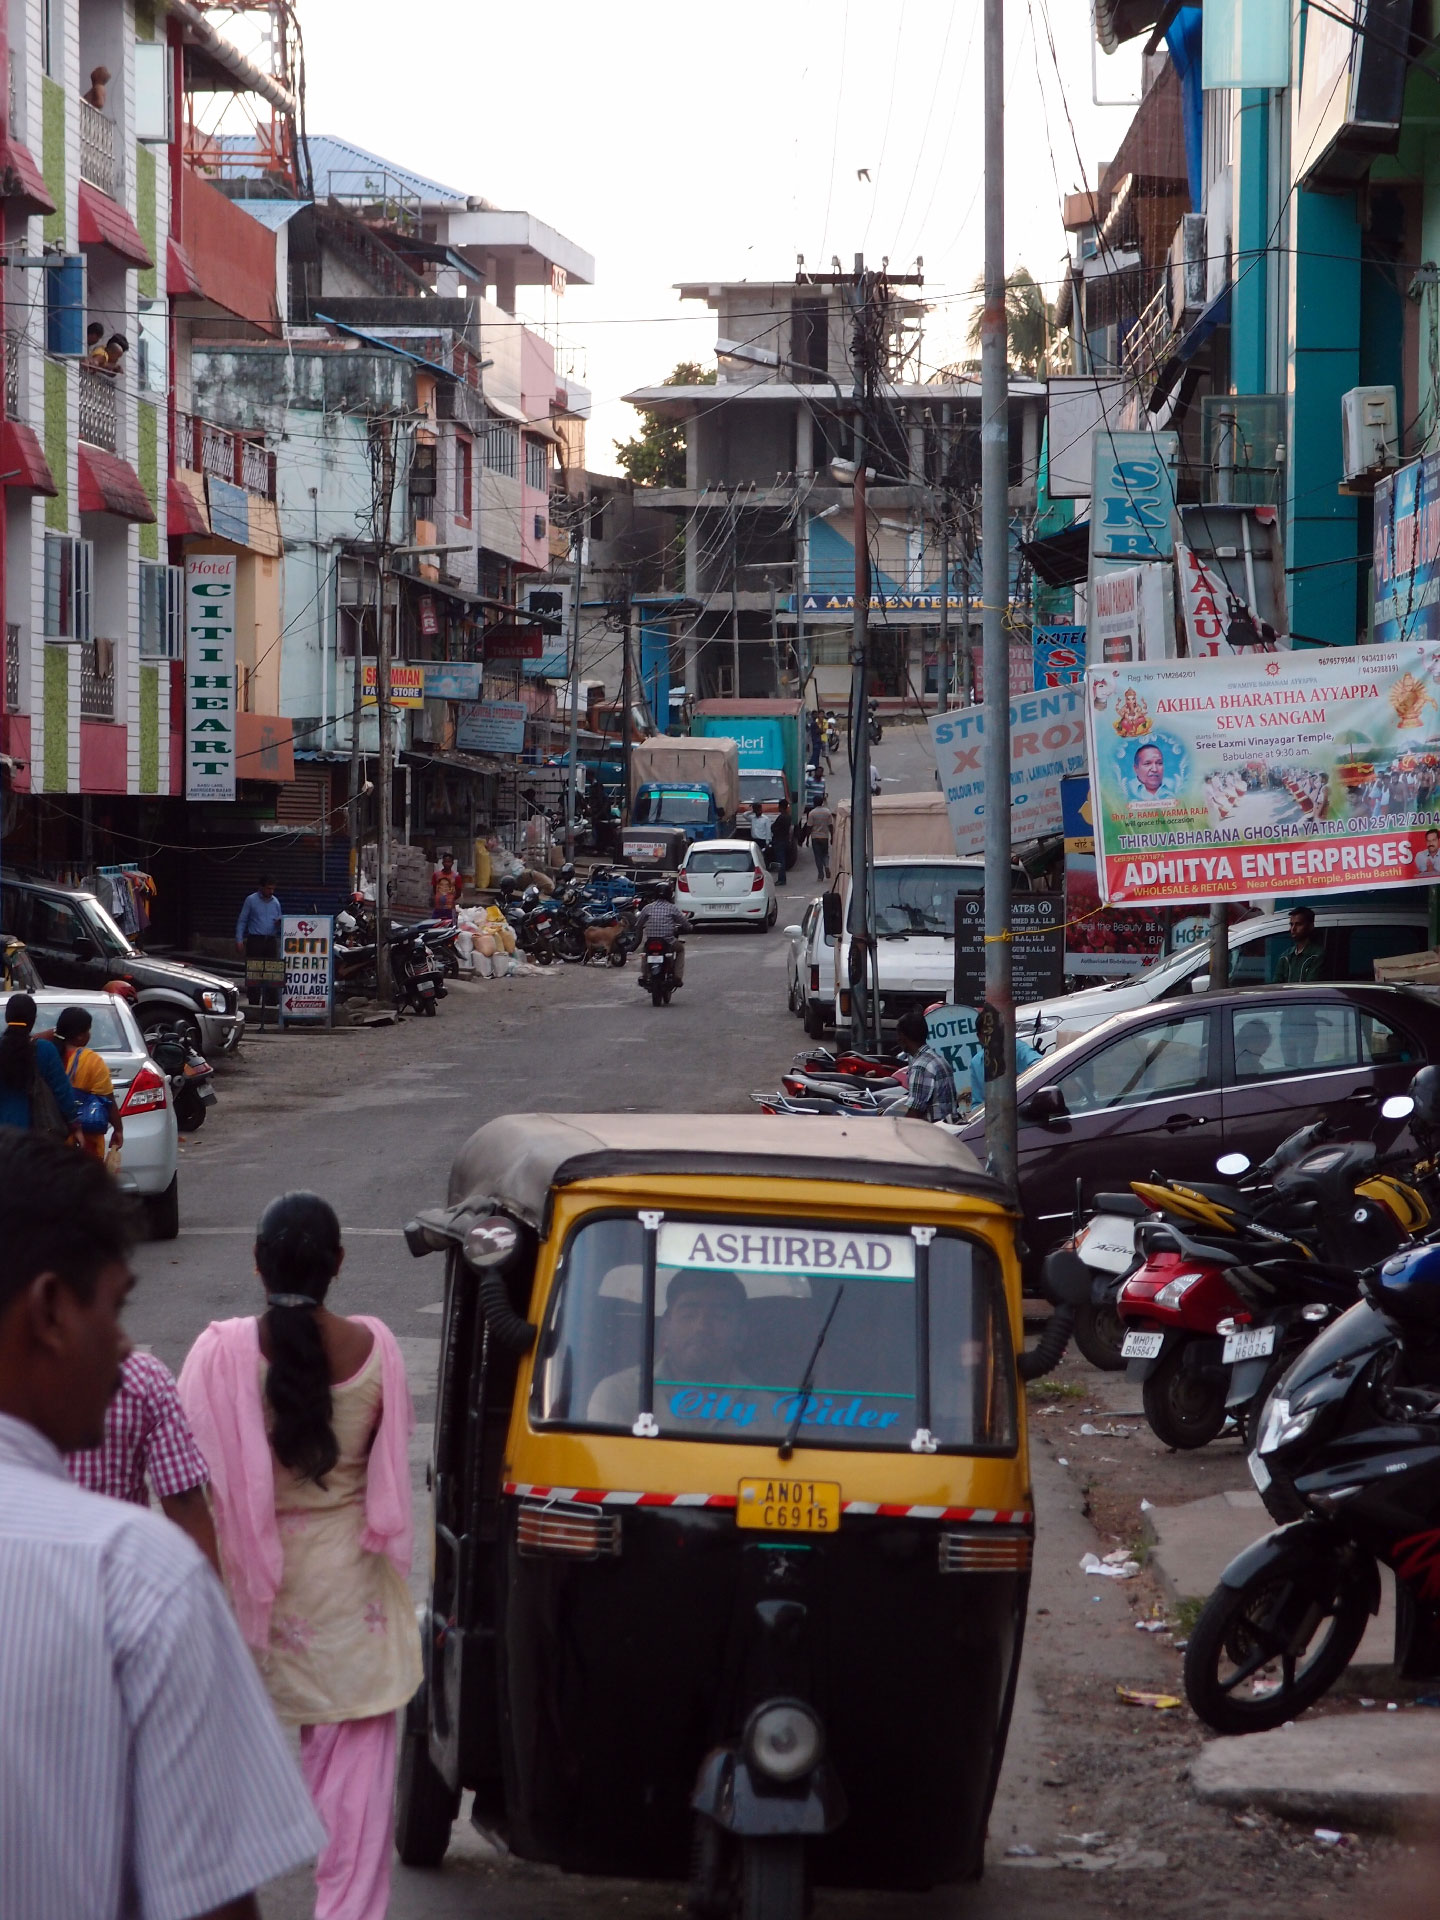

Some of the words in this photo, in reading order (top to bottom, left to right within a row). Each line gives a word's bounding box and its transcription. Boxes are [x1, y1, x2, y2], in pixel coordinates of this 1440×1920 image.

[187, 560, 235, 575] Hotel
[190, 583, 232, 662] CITI
[492, 646, 533, 655] TRAVELS
[390, 669, 420, 685] MMAN
[393, 687, 419, 697] STORE
[1156, 696, 1216, 713] AKHILA
[1219, 688, 1307, 709] BHARATHA
[1310, 684, 1379, 703] AYYAPPA
[189, 675, 233, 775] HEART
[936, 691, 1079, 744] STENT
[1217, 714, 1255, 730] SEVA
[1259, 708, 1326, 728] SANGAM
[1196, 740, 1217, 750] Sree
[1218, 738, 1246, 749] Laxmi
[1248, 734, 1296, 747] Vinayagar
[1297, 732, 1335, 744] Temple,
[1222, 751, 1264, 762] Babulane
[1265, 750, 1274, 759] at
[1275, 748, 1294, 757] 9:30
[1137, 811, 1159, 820] RAMA
[1161, 809, 1188, 818] VARMA
[1190, 807, 1209, 816] RAJA
[1118, 828, 1240, 850] THIRUVABHARANA
[1244, 823, 1299, 841] GHOSHA
[1302, 818, 1345, 836] YATRA
[1348, 816, 1367, 832] ON
[1371, 810, 1440, 829] 25/12/2014
[1136, 820, 1155, 828] grace
[1166, 816, 1195, 825] occasion
[1124, 856, 1235, 888] ADHITYA
[1240, 840, 1414, 878] ENTERPRISES
[1133, 887, 1190, 897] WHOLESALE
[1200, 882, 1238, 892] RETAILS
[1247, 880, 1269, 889] Near
[1270, 877, 1306, 888] Ganesh
[1306, 874, 1344, 885] Temple,
[1345, 871, 1372, 881] Bathu
[1373, 867, 1402, 878] Basthi
[1113, 921, 1142, 934] Beauty
[1145, 923, 1156, 932] BE
[284, 937, 328, 954] CITI
[284, 956, 328, 970] HEART
[286, 973, 327, 984] ROOMS
[282, 985, 329, 996] AVAILABLE
[927, 1018, 978, 1040] HOTEL
[688, 1232, 892, 1272] ASHIRBAD
[1132, 1335, 1155, 1346] MH01
[1236, 1334, 1263, 1347] AN01
[1124, 1345, 1156, 1356] BN5847
[669, 1387, 758, 1427] City
[772, 1392, 900, 1429] Rider
[1385, 1462, 1408, 1473] Hero
[765, 1482, 815, 1503] AN01
[764, 1506, 828, 1529] C6915
